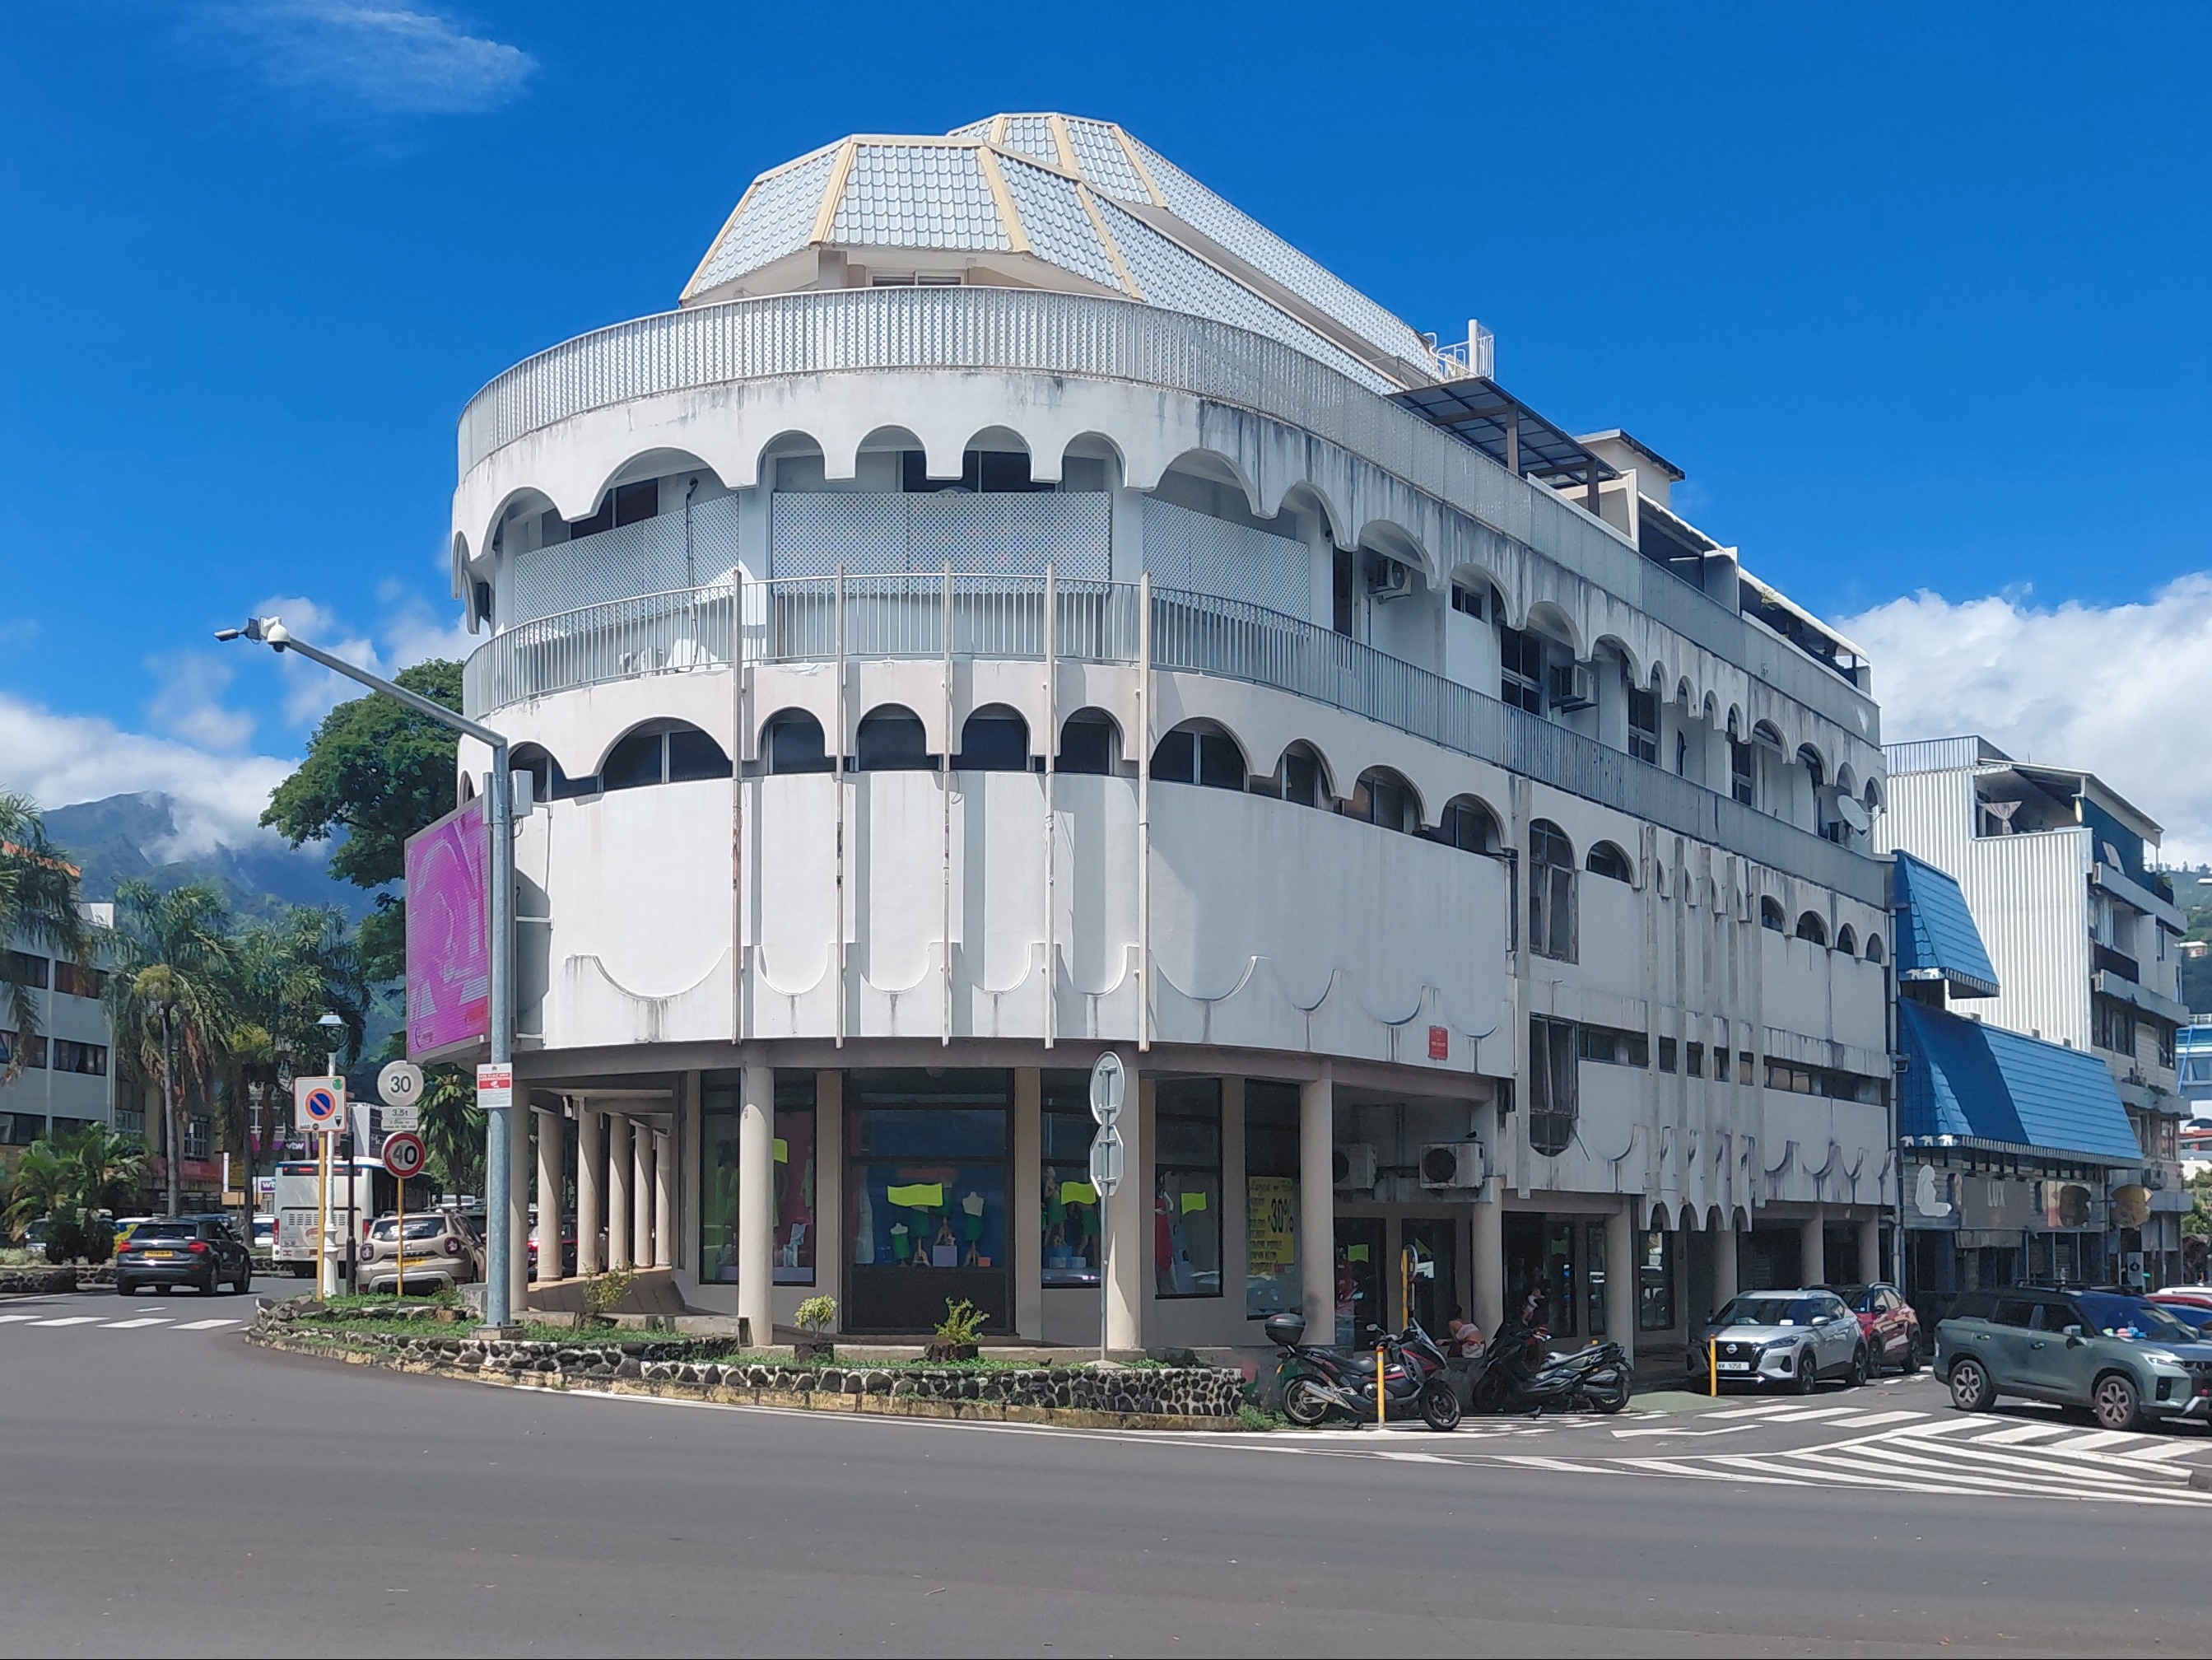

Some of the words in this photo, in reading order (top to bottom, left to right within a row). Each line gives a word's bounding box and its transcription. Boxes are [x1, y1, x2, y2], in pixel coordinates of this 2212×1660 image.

[390, 1075, 412, 1093] 30
[392, 1144, 417, 1165] 40
[1987, 1181, 2005, 1207] LUX
